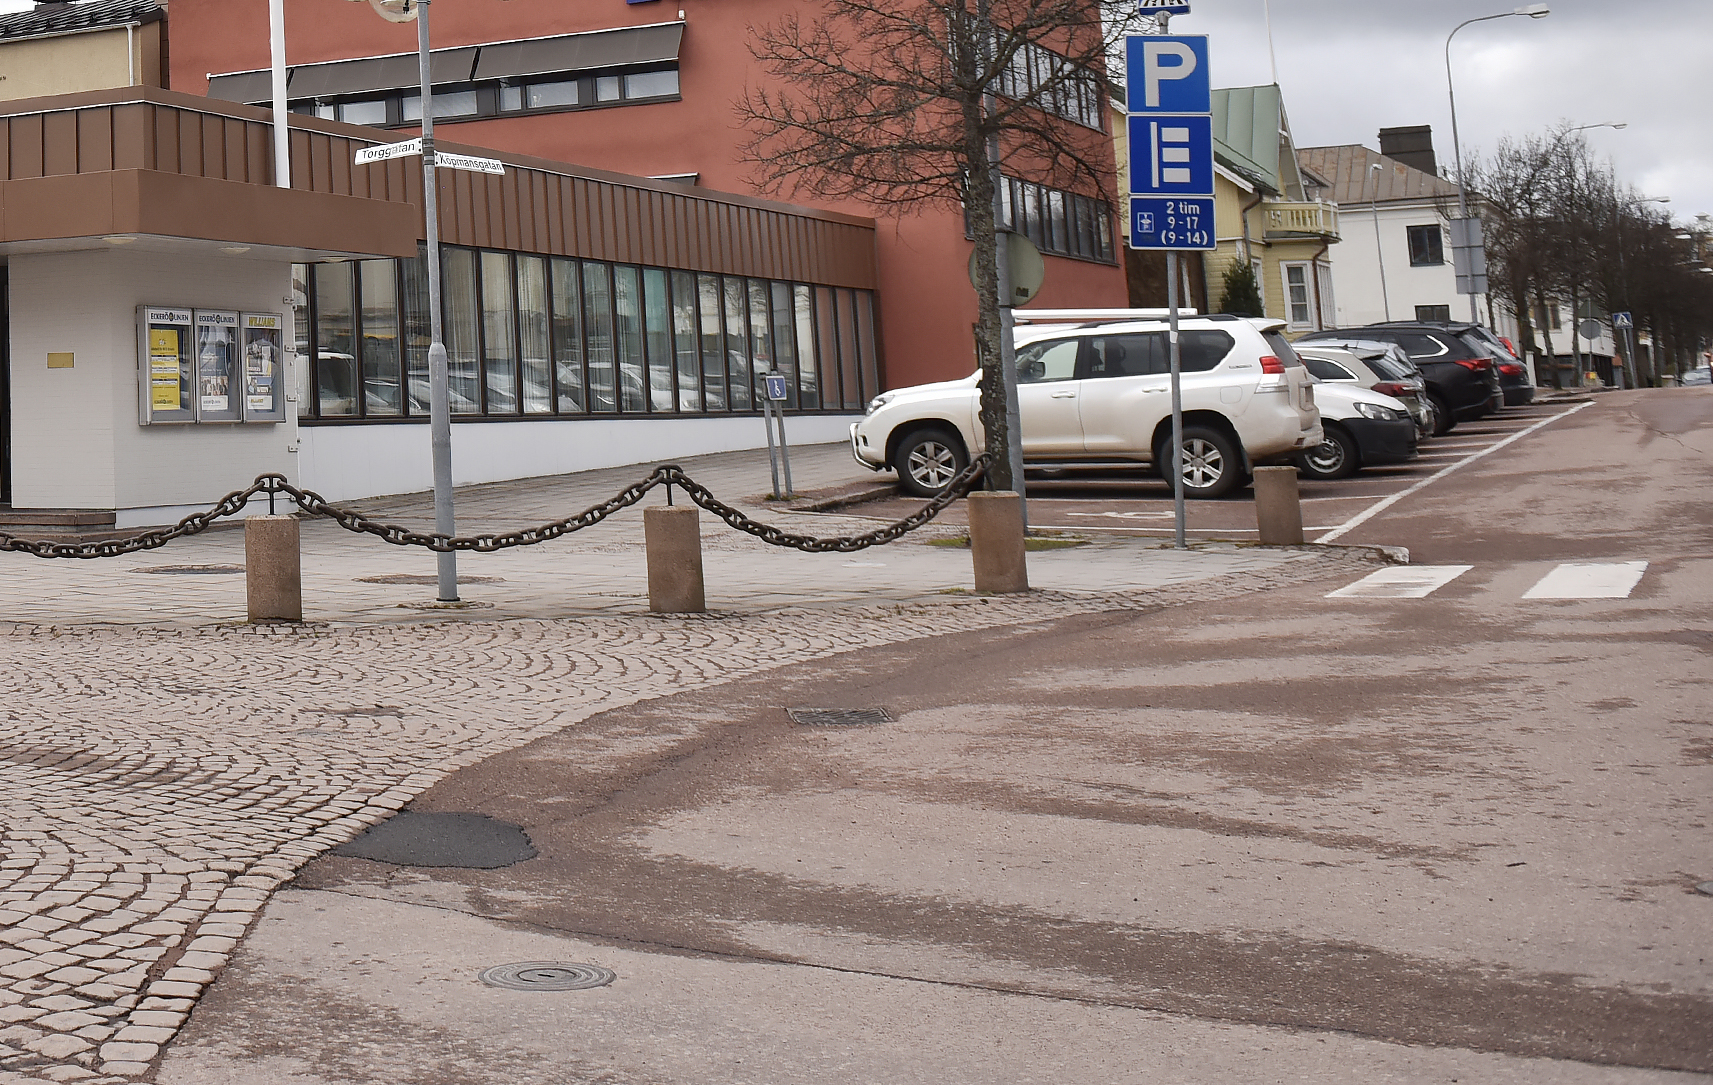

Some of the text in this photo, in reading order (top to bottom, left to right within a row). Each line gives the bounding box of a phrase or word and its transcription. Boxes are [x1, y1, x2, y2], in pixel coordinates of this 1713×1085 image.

[1143, 41, 1198, 108] P
[362, 142, 415, 159] Torggatan
[439, 153, 503, 172] Köpmansgatan
[1166, 201, 1200, 215] 2 tim
[248, 316, 276, 328] WILLIAMS
